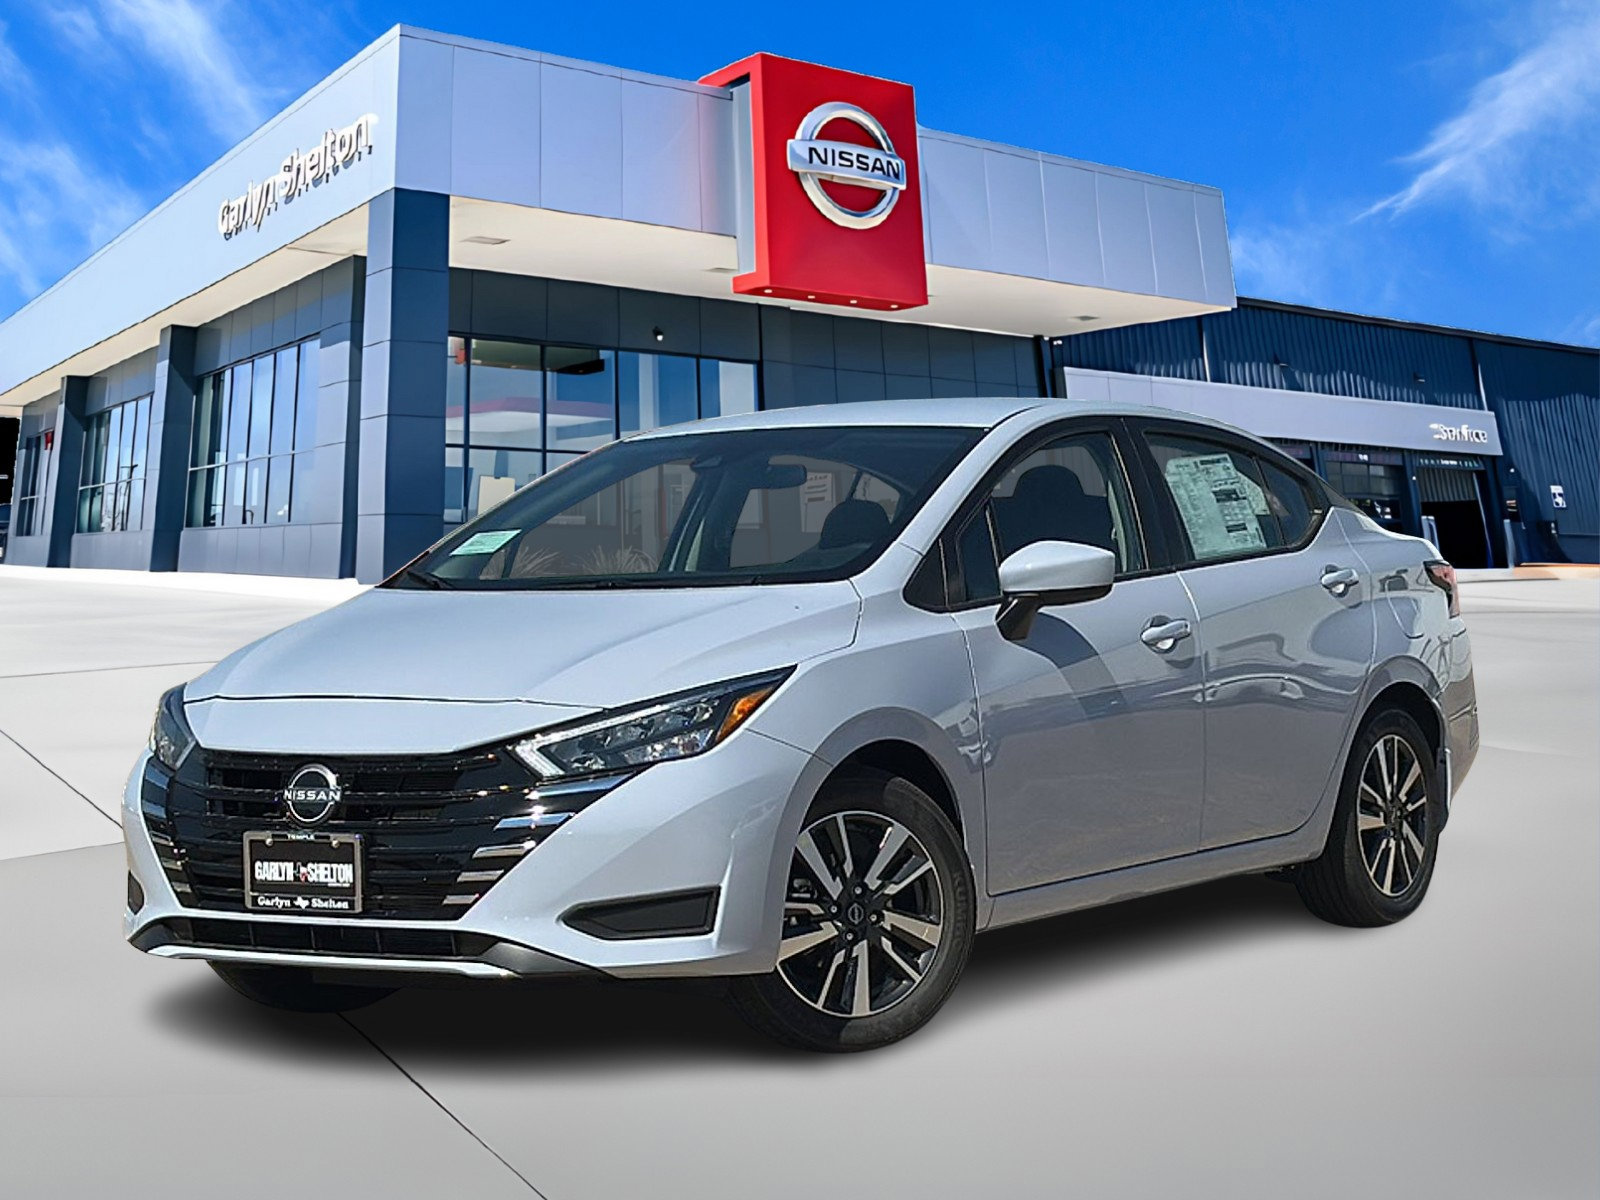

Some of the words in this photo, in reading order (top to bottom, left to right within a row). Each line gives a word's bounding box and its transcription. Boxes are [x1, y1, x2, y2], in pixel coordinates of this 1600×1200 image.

[279, 114, 375, 204] Shelton
[808, 147, 900, 180] NISSAN
[283, 789, 342, 801] NISSAN
[255, 861, 294, 882] GARLYN
[307, 862, 354, 883] SHELTON
[258, 896, 291, 909] Garlyn
[311, 897, 349, 910] Shelton
